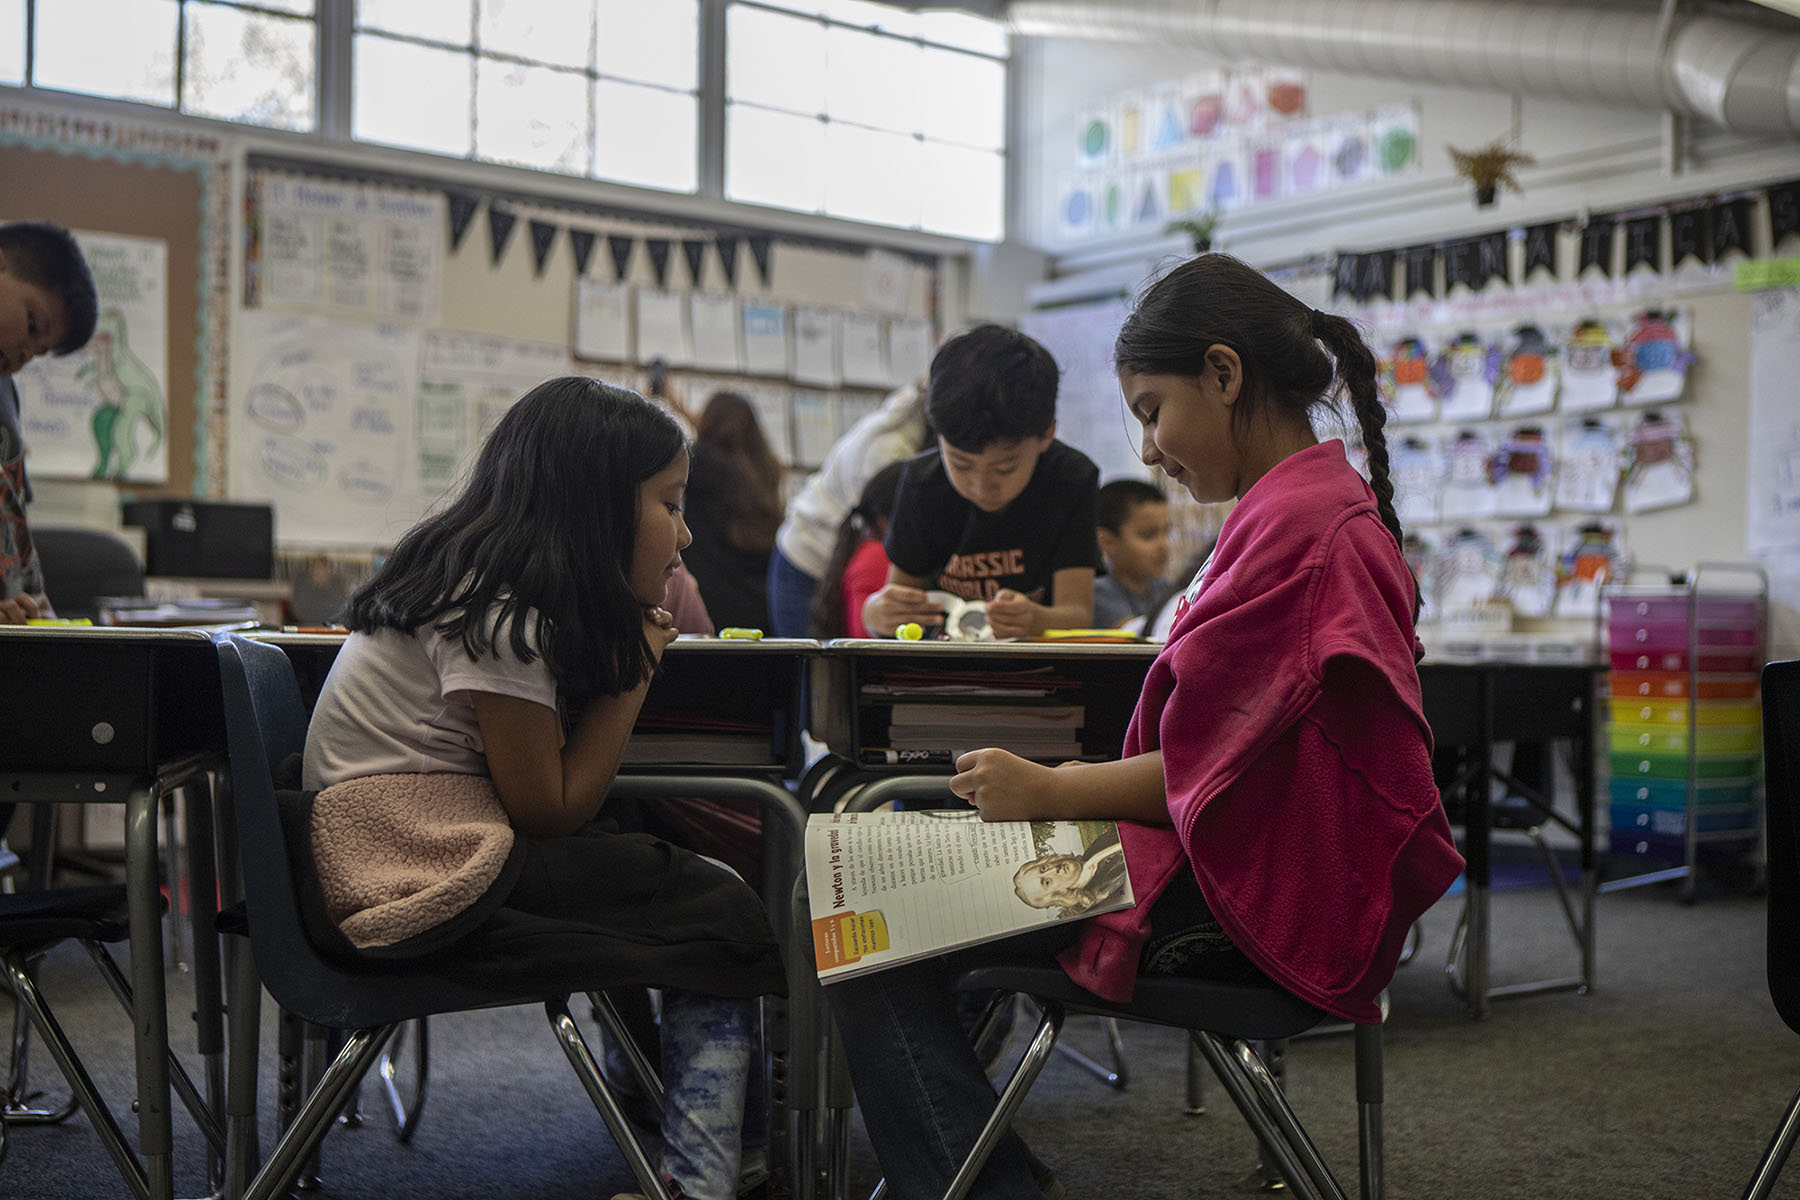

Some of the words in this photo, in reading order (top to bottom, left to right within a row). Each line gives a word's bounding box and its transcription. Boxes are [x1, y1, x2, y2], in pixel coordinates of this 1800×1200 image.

[899, 750, 930, 762] EXPO
[828, 830, 842, 853] gravedad
[829, 855, 840, 863] la
[832, 872, 845, 909] Newton
